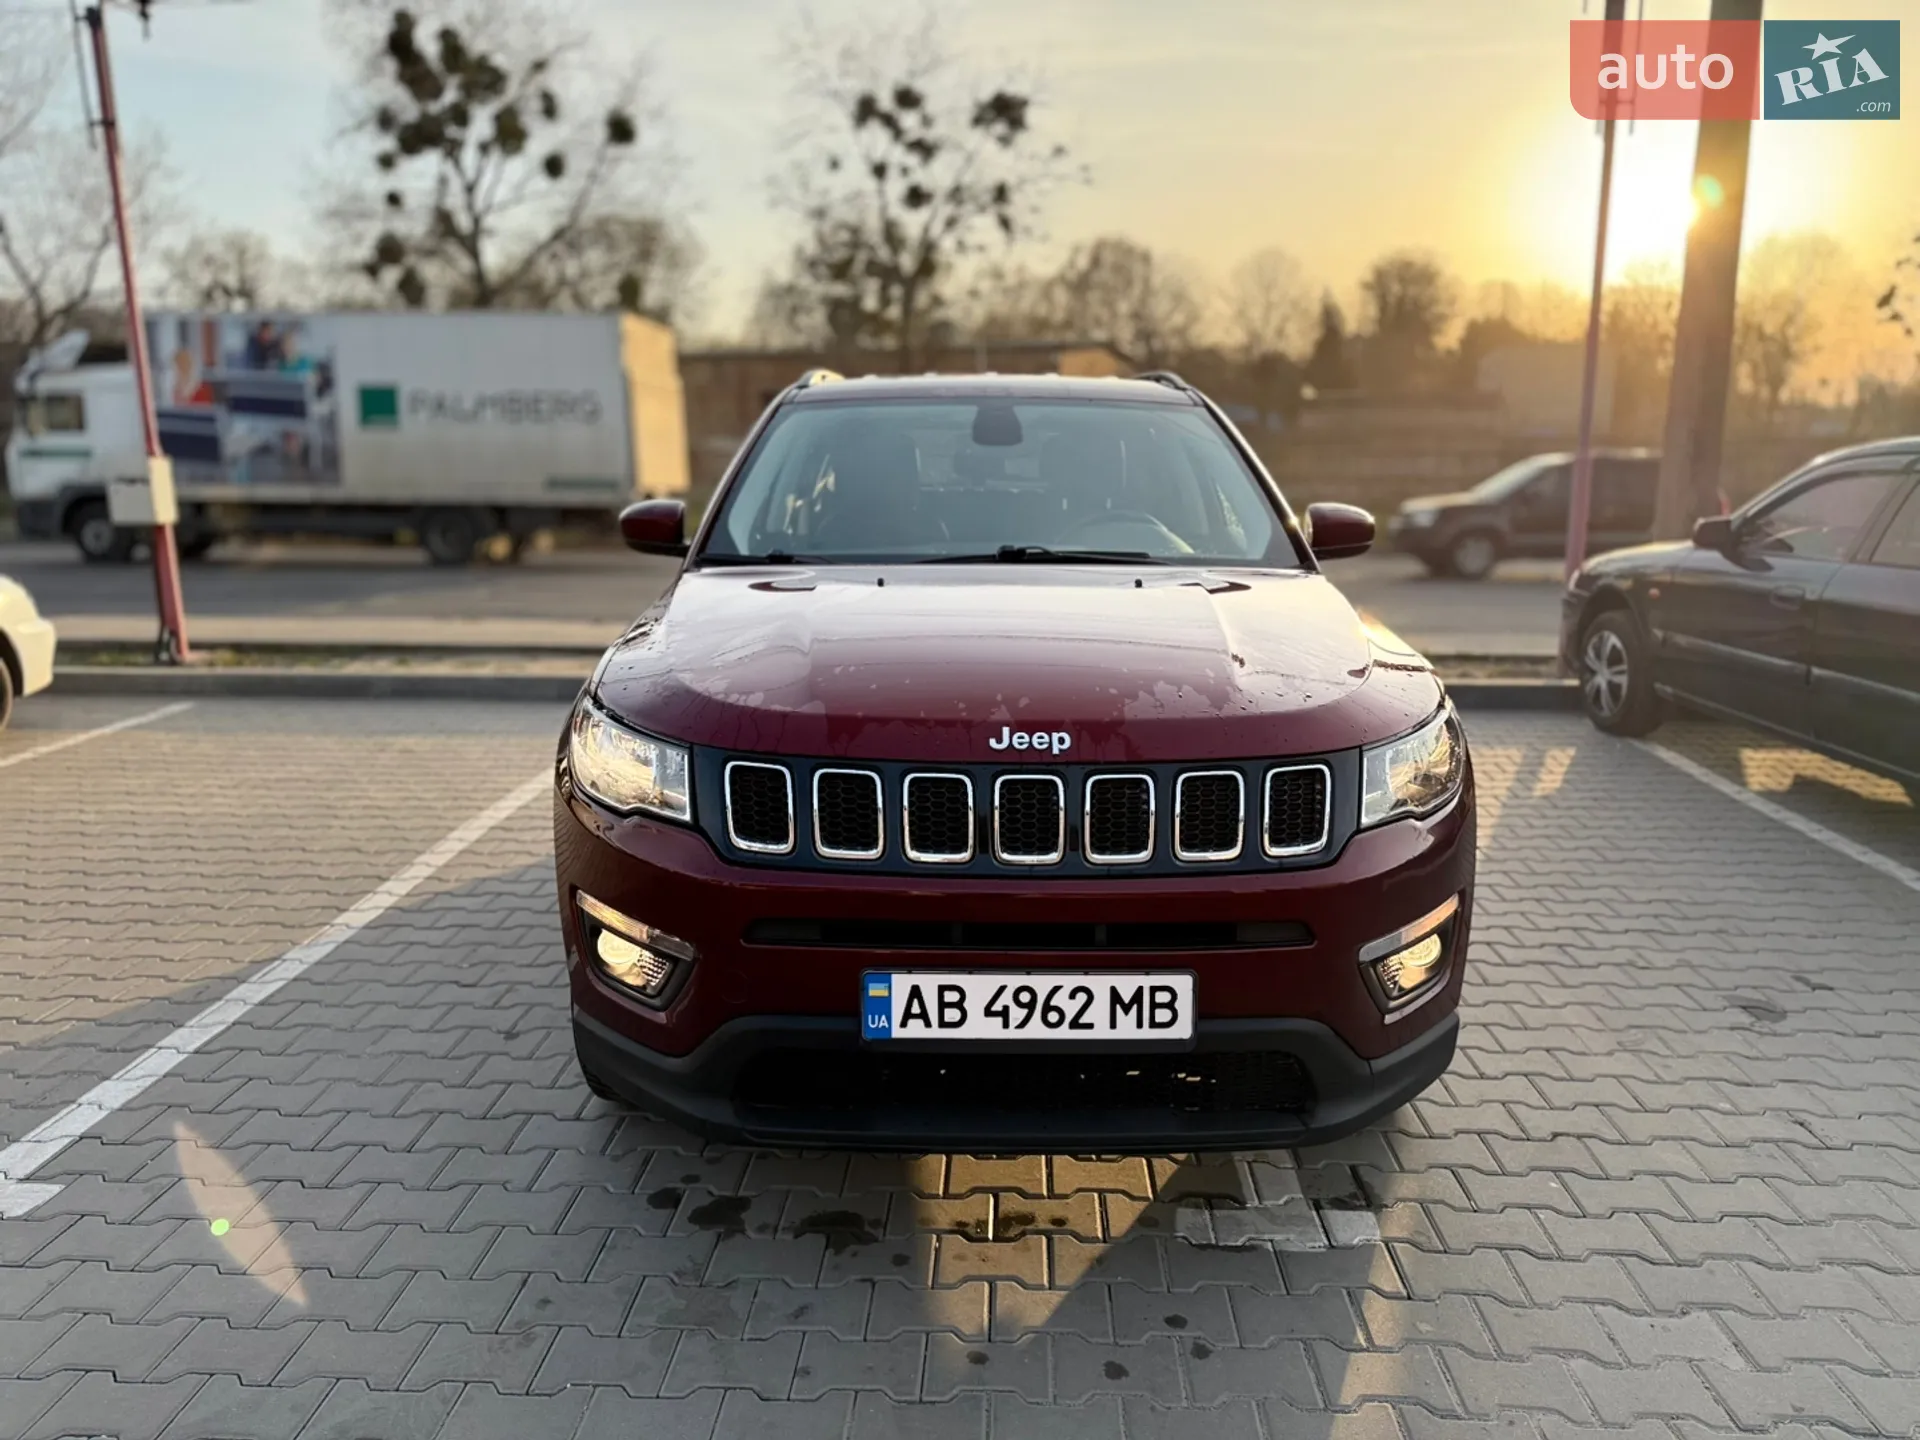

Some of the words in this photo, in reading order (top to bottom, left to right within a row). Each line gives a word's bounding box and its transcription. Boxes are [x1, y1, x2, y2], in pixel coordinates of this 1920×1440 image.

[988, 726, 1072, 755] Jeep
[868, 1014, 889, 1029] UA
[899, 984, 968, 1030] AB
[983, 984, 1095, 1030] 4962
[1109, 984, 1179, 1030] MB
